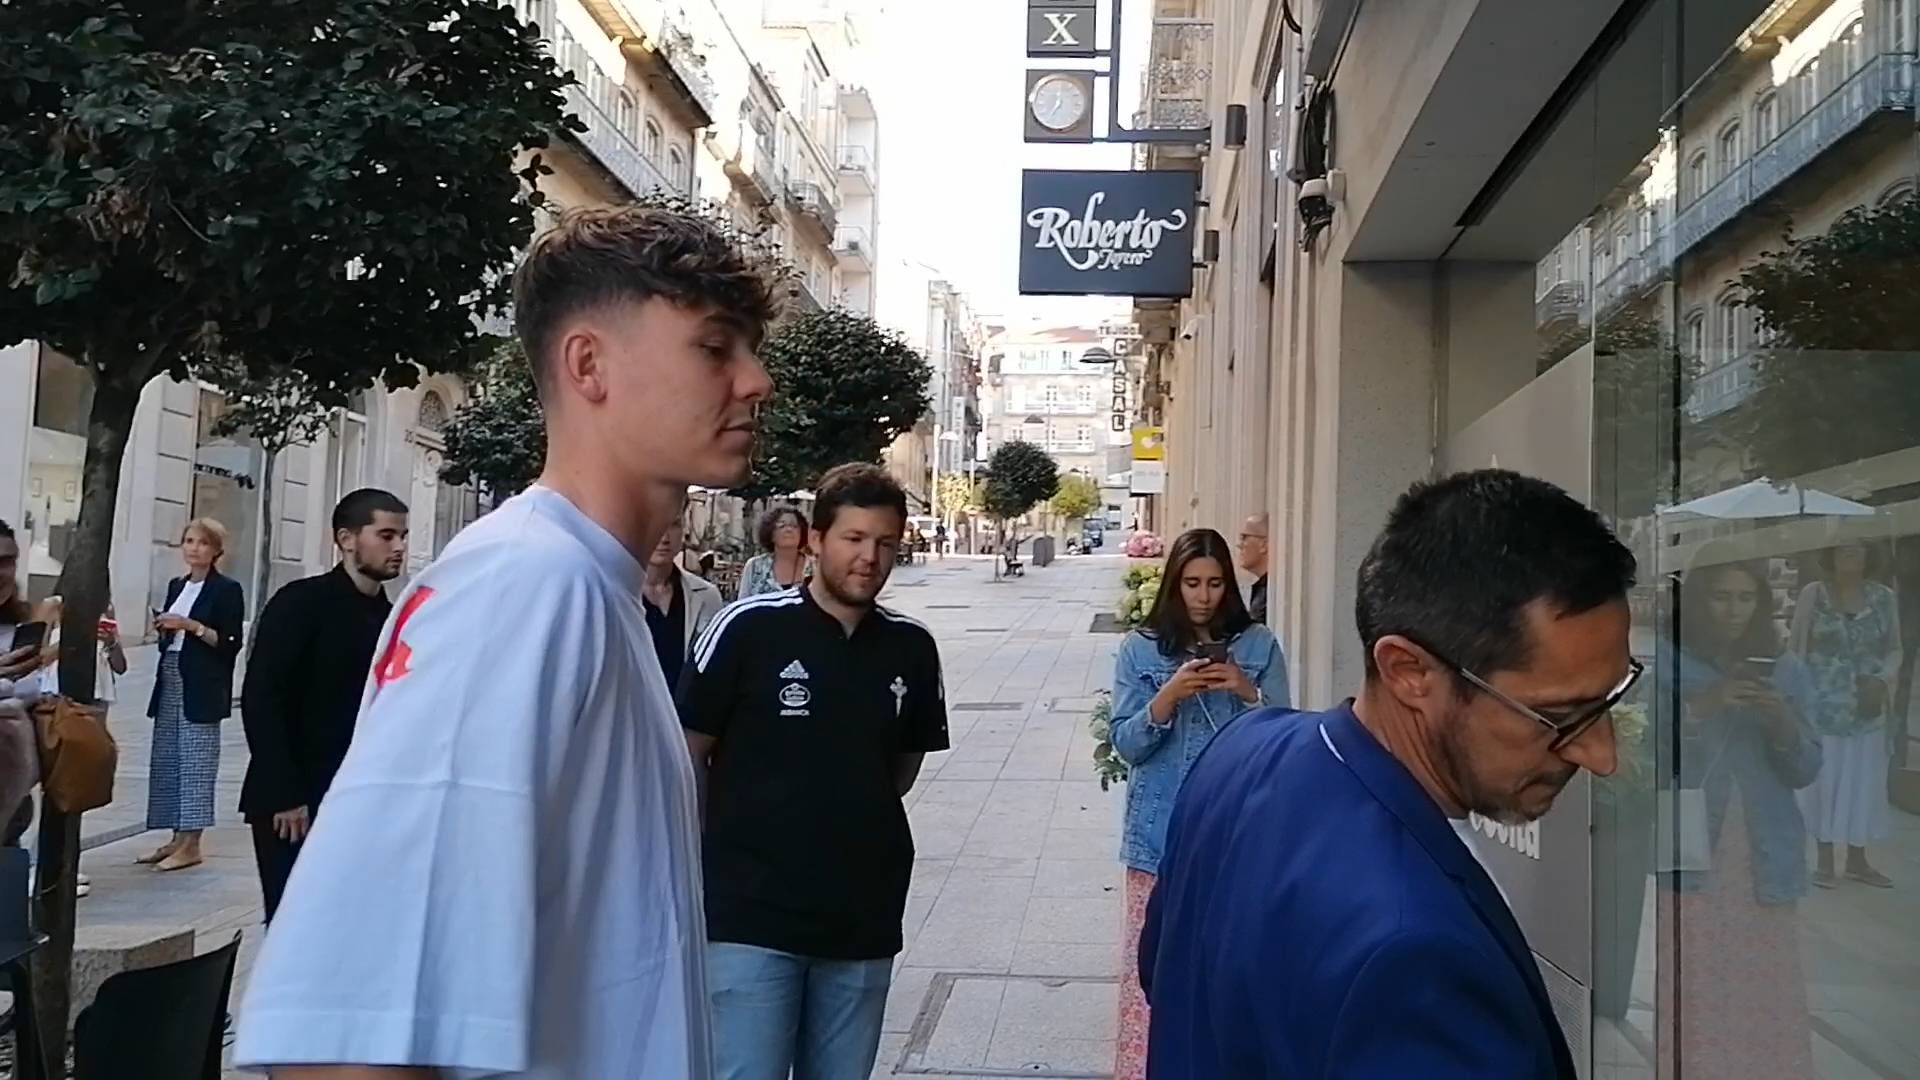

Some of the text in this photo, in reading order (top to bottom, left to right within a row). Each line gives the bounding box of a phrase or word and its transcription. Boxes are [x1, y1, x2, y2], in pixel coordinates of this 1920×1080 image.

[1042, 13, 1079, 46] X
[1027, 192, 1187, 270] Roberto
[1112, 338, 1128, 432] CASAL
